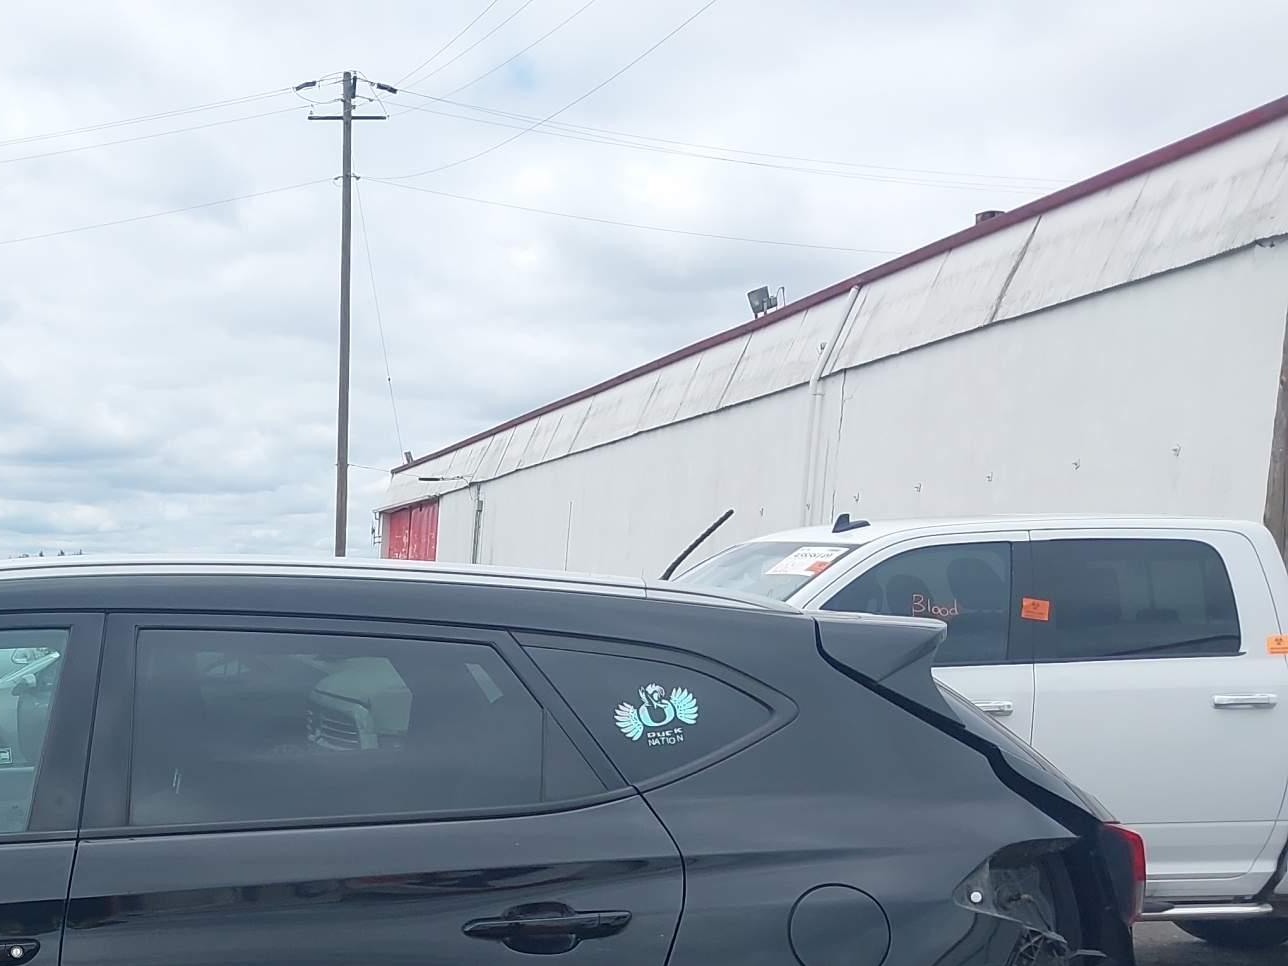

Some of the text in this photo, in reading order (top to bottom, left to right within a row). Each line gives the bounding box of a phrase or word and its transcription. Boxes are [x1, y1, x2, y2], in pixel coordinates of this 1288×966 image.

[912, 594, 959, 617] Blood
[647, 727, 683, 738] DUCK
[648, 734, 684, 746] NATION
